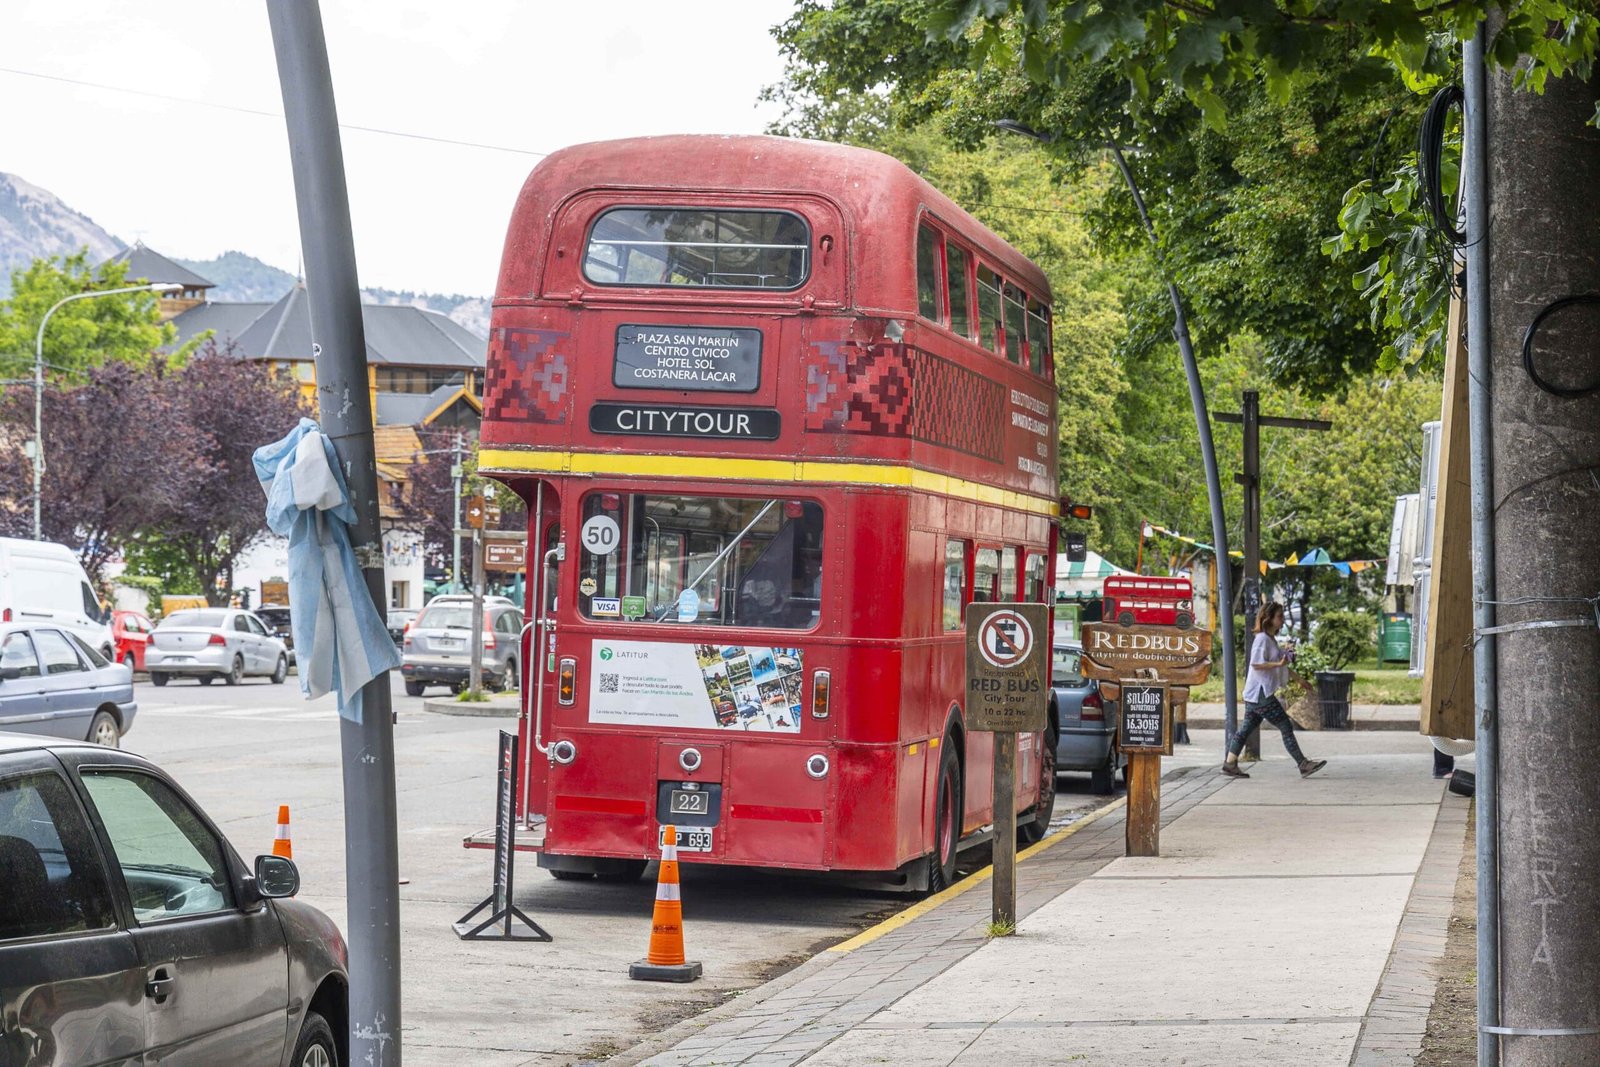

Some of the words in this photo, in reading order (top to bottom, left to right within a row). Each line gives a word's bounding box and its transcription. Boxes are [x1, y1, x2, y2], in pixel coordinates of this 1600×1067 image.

[637, 333, 671, 345] PLAZA
[673, 335, 695, 346] SAN
[698, 336, 739, 348] MARTIN
[644, 345, 689, 357] CENTRO
[692, 347, 730, 359] CIVICO
[657, 357, 692, 369] HOTEL
[694, 359, 716, 370] SOL
[634, 368, 698, 380] COSTANERA
[701, 371, 737, 383] LACAR
[616, 410, 751, 434] CITYTOUR
[587, 526, 613, 545] 50
[597, 603, 616, 611] VISA
[1092, 631, 1200, 654] REDBUS
[970, 678, 1002, 692] RED
[1007, 678, 1040, 693] BUS
[984, 694, 1002, 704] City
[1004, 694, 1026, 703] Tour
[984, 708, 994, 716] 10
[1004, 708, 1014, 716] 22
[678, 794, 701, 810] 22
[688, 833, 711, 848] 693
